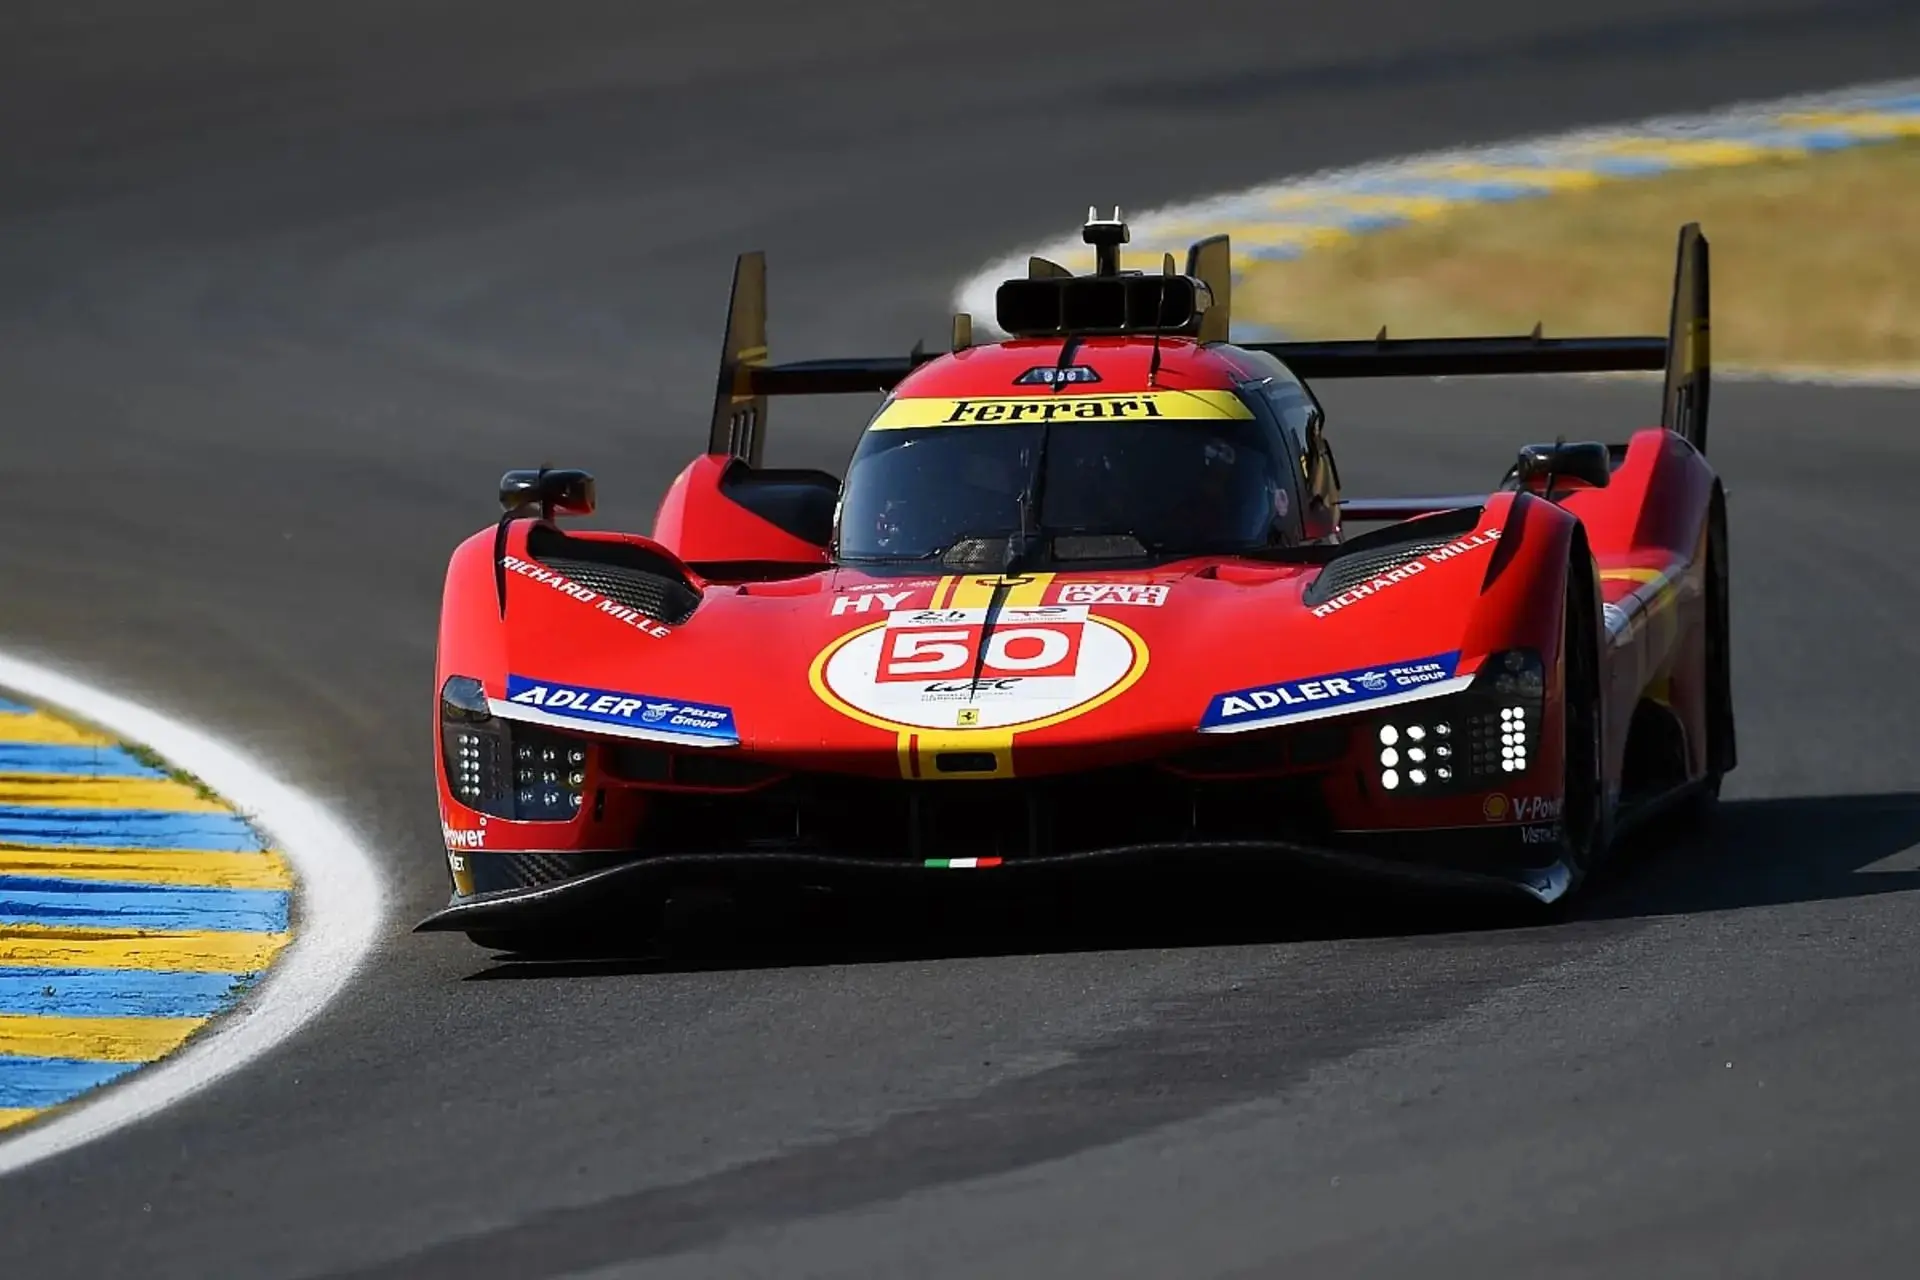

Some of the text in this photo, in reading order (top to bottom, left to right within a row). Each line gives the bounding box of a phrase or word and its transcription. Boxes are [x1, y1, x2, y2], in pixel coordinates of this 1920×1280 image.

[942, 395, 1164, 424] Ferrari
[1311, 527, 1503, 618] RICHARD MILLE
[499, 555, 672, 639] RICHARD MILLE
[831, 591, 915, 616] HY
[1065, 591, 1159, 604] CAR
[888, 628, 1070, 675] 50
[1389, 662, 1441, 677] PELZER
[1396, 670, 1447, 685] GROUP
[510, 685, 644, 718] ADLER
[1221, 676, 1355, 717] ADLER
[670, 714, 719, 729] GROUP
[679, 706, 727, 720] PELZER
